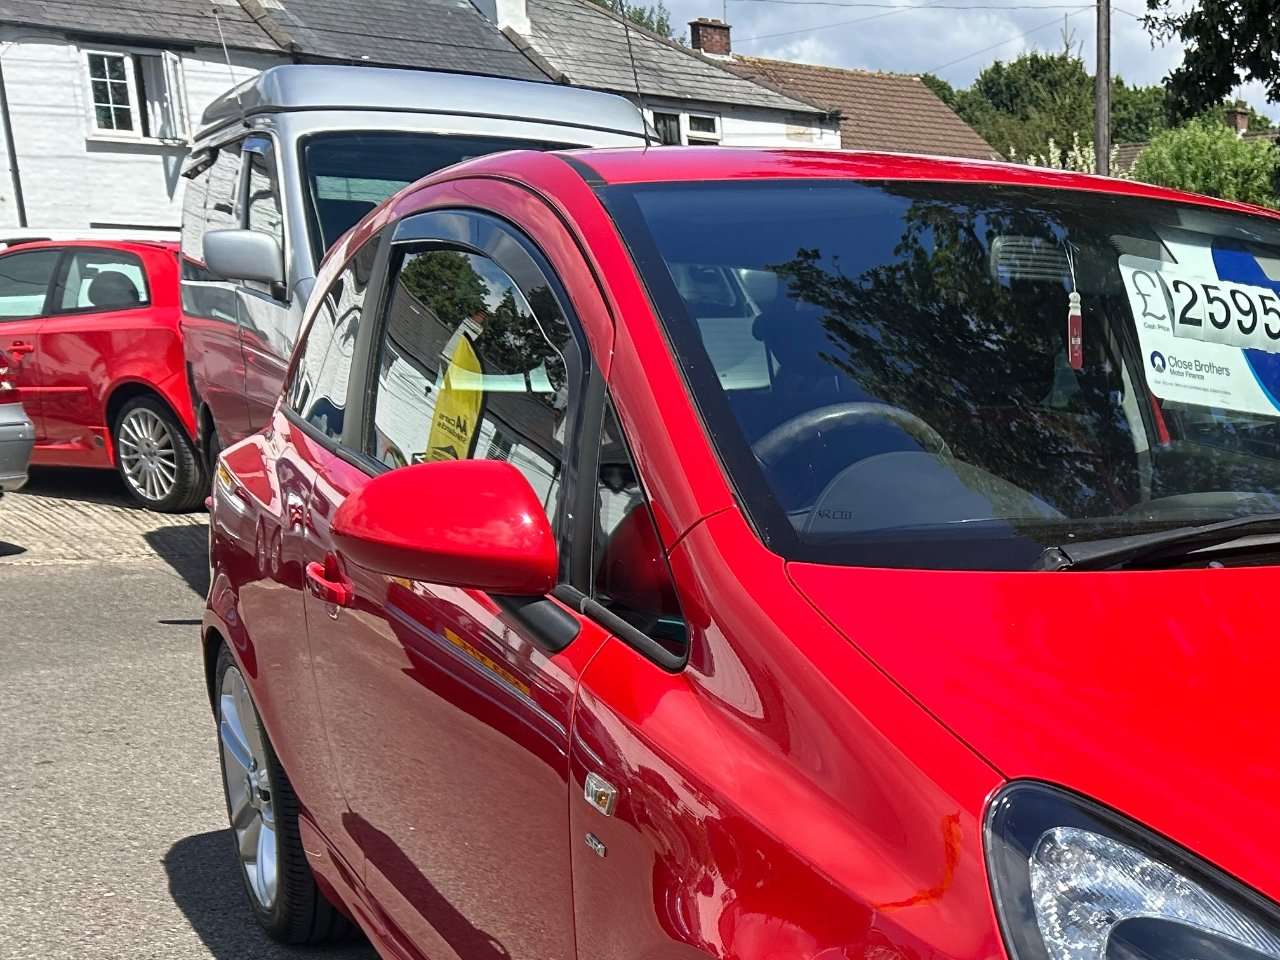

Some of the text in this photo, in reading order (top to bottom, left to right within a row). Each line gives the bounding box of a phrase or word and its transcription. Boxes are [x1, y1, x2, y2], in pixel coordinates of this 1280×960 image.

[1168, 355, 1232, 377] Close Brothers
[1170, 368, 1205, 381] Motor Finance
